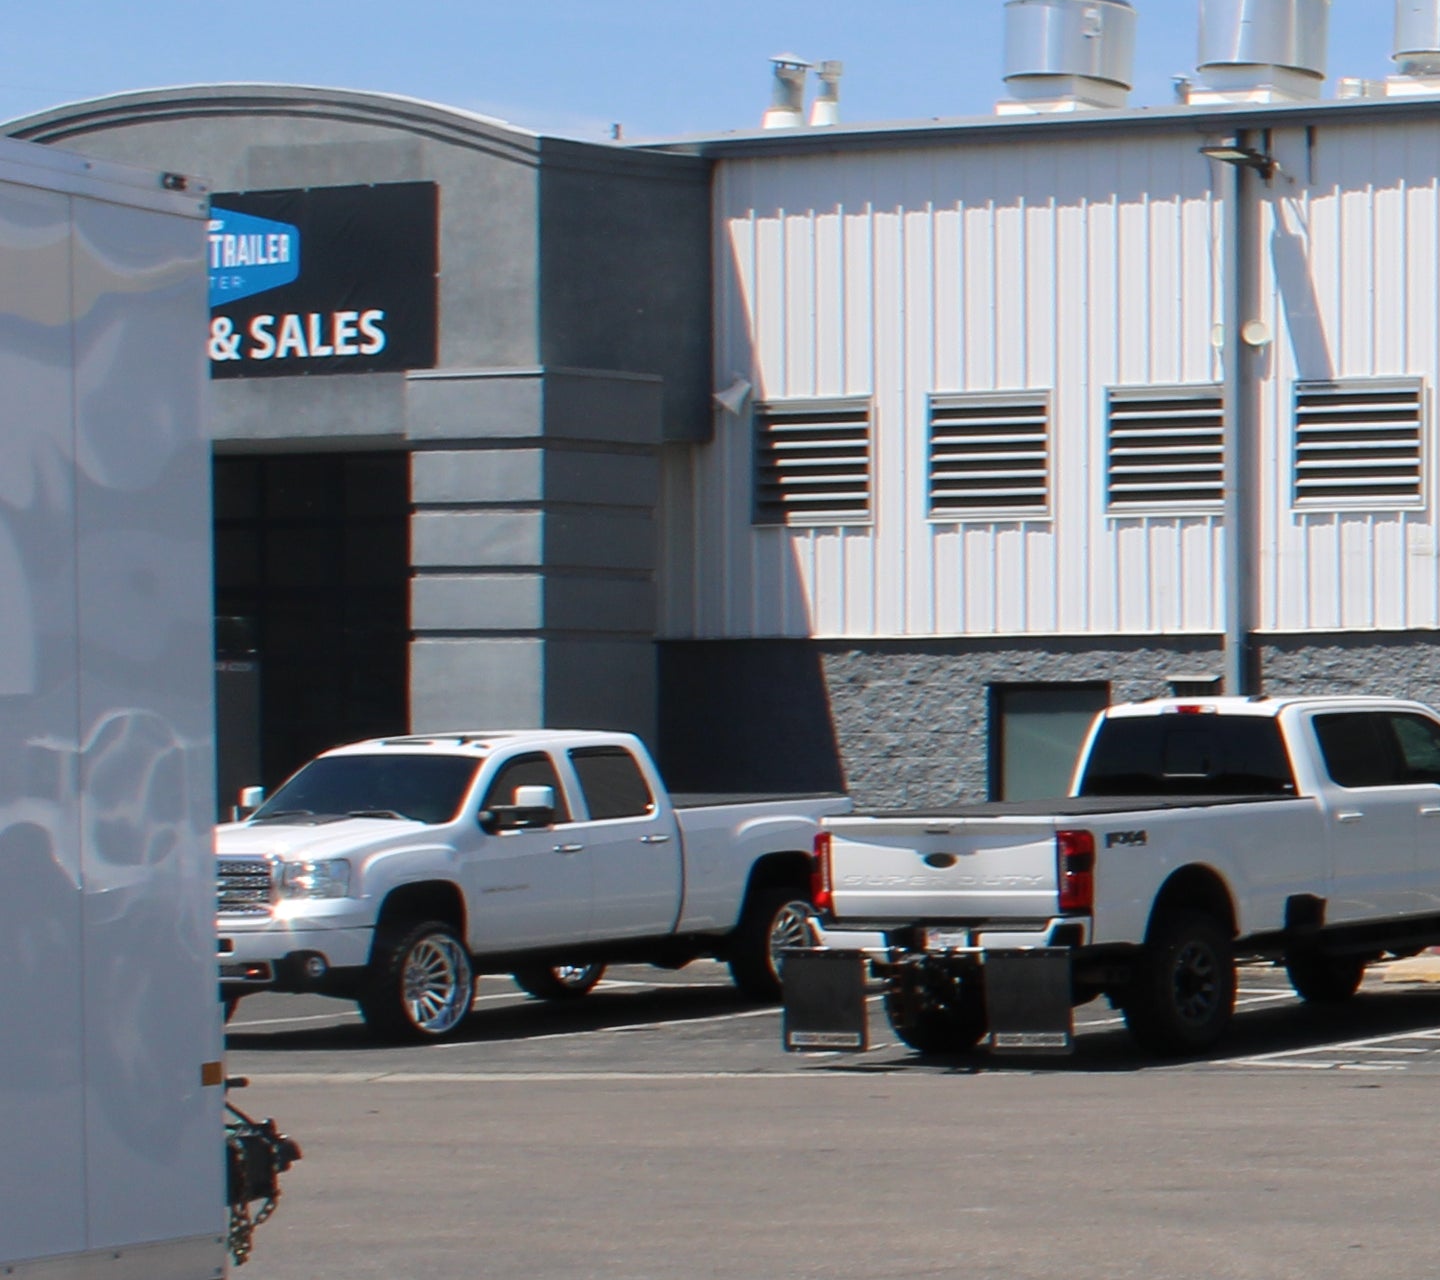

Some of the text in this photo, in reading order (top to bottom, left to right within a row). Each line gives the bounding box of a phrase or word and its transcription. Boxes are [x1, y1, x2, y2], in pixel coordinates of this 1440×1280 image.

[209, 234, 290, 268] TRAILER
[209, 275, 244, 290] TER
[208, 309, 386, 361] & SALES
